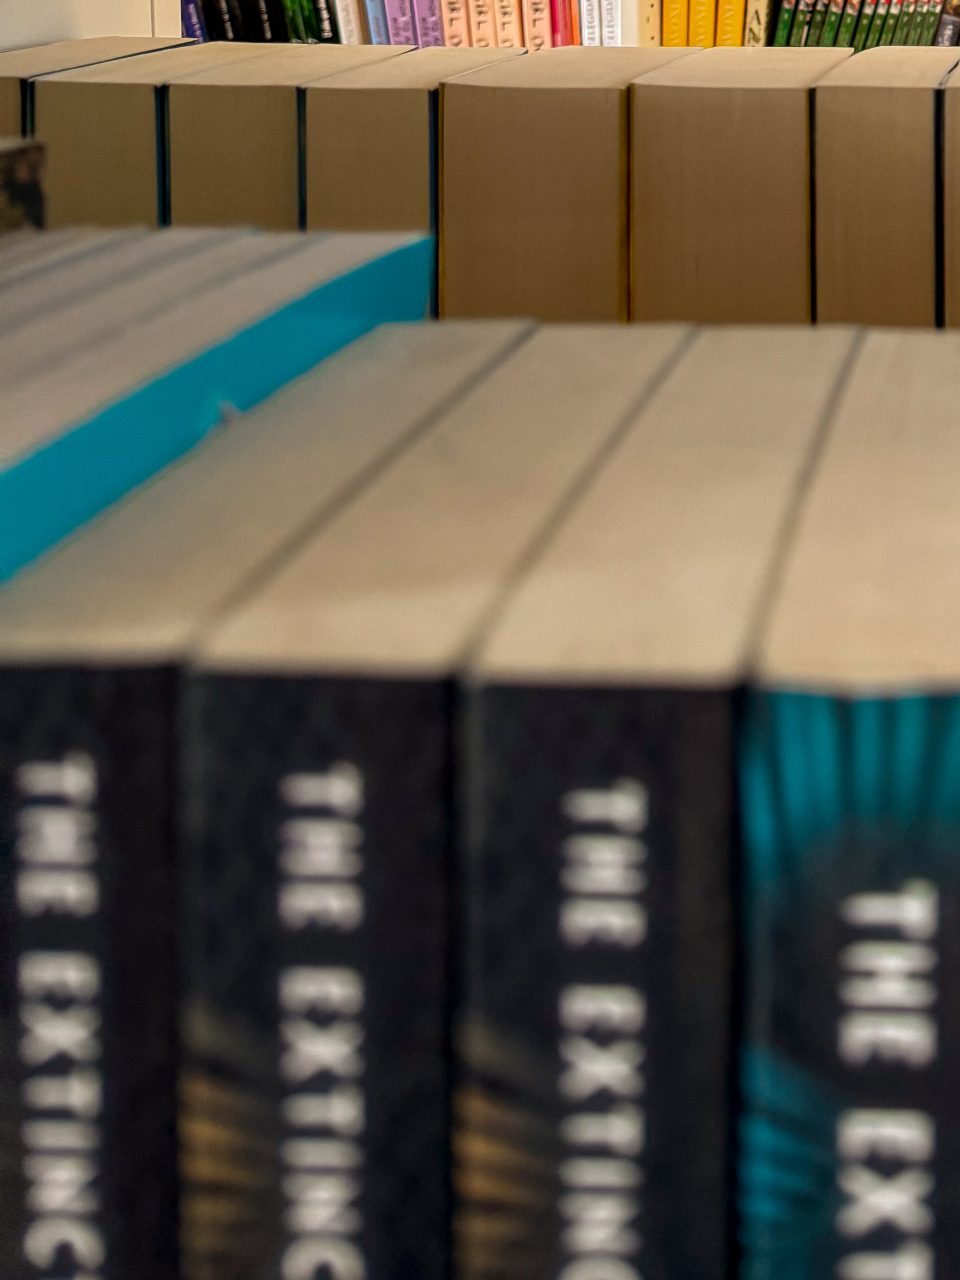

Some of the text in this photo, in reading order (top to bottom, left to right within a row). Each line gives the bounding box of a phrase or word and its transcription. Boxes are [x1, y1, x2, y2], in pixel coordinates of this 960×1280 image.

[280, 762, 362, 929] THE
[560, 779, 646, 946] THE
[17, 754, 105, 1280] THE EXTINC
[838, 878, 938, 1066] THE
